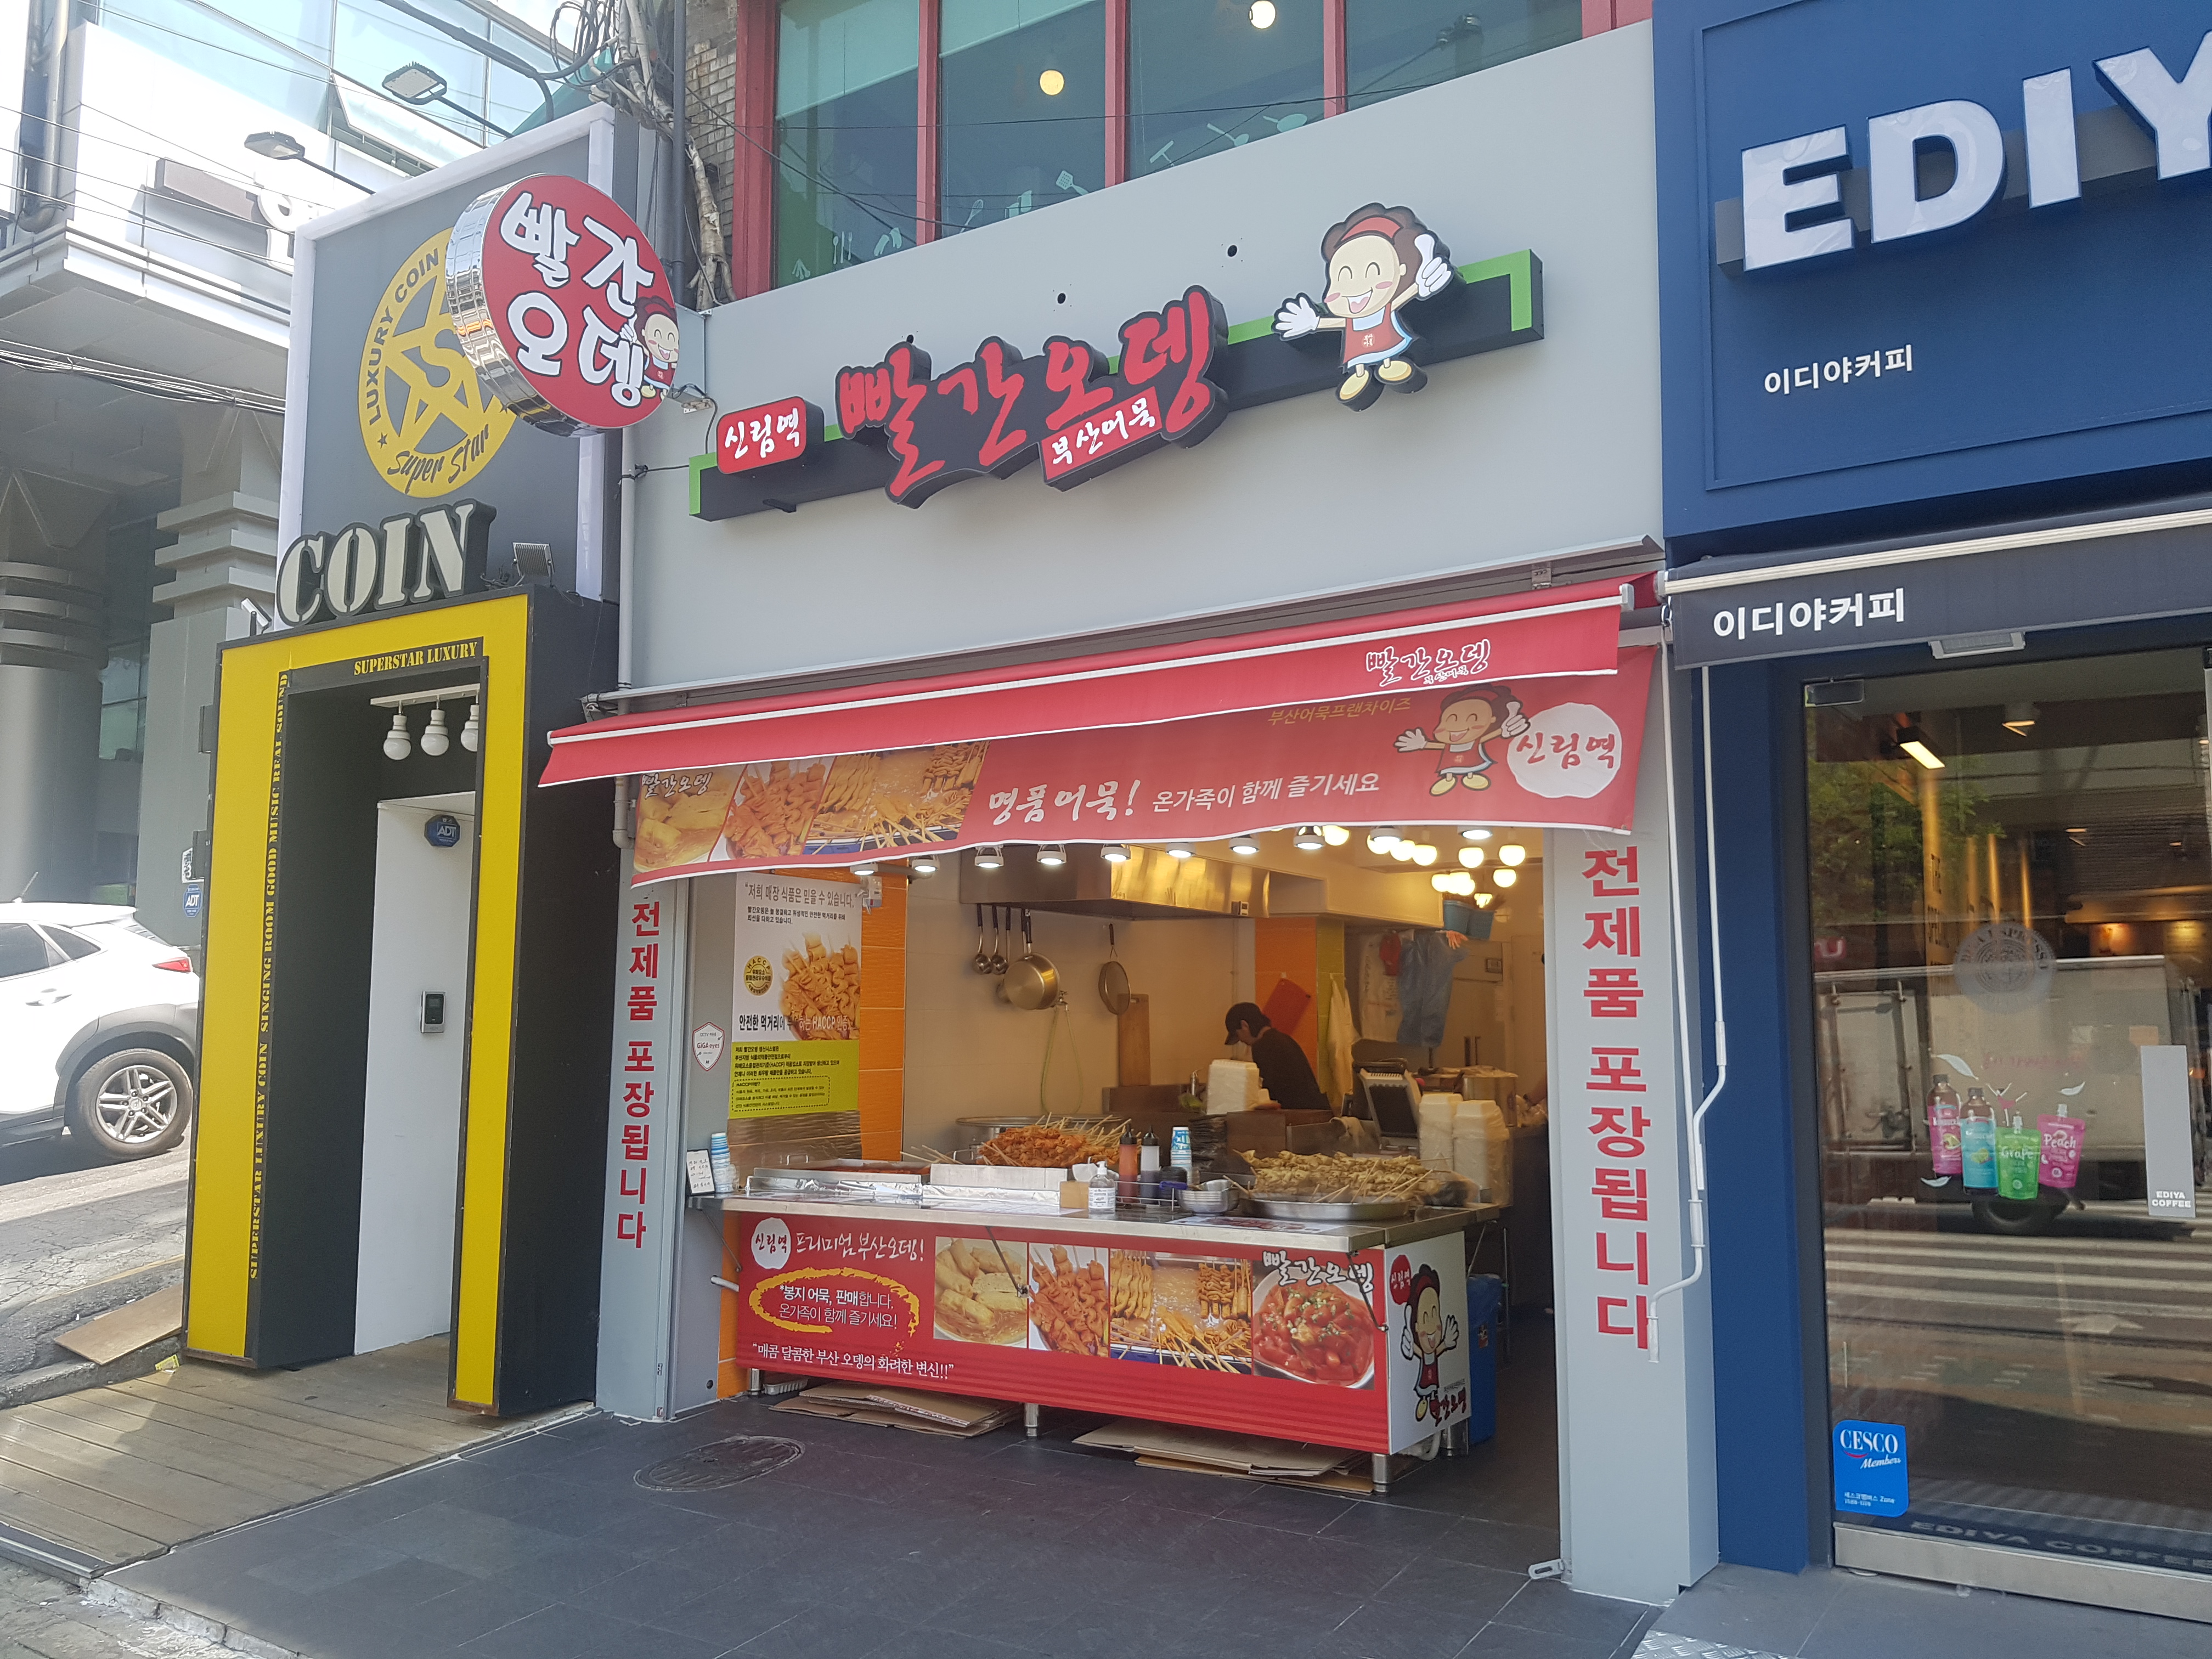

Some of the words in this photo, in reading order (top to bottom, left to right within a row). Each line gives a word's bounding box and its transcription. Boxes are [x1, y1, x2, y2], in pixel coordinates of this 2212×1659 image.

[500, 193, 655, 318] 빨간
[366, 306, 393, 426] LUXURY
[394, 249, 439, 303] COIN
[506, 291, 644, 408] 오뎅
[1764, 345, 1914, 394] 이디야커피
[839, 290, 1212, 498] 빨간오뎅
[723, 409, 802, 460] 신림역
[1049, 397, 1156, 465] 부산어묵
[387, 450, 444, 494] Super
[448, 424, 489, 484] Star
[277, 502, 475, 627] COIN
[1713, 588, 1904, 639] 이디야커피
[353, 651, 424, 676] SUPERSTAR
[427, 642, 477, 663] LUXURY
[1366, 639, 1491, 687] 빨간오뎅
[276, 674, 288, 732] SOUND
[1268, 697, 1410, 725] 부산어묵프랜차이즈
[273, 736, 282, 782] REAL
[1516, 732, 1616, 769] 신림역
[642, 771, 713, 800] 빨간오뎅
[989, 785, 1048, 826] 명품
[1054, 779, 1141, 821] 어묵!
[1153, 788, 1234, 813] 온가족이
[1241, 777, 1283, 805] 함께
[1286, 772, 1380, 798] 즐기세요
[269, 787, 280, 842] MUSIC
[437, 826, 456, 837] ADT
[267, 848, 277, 896] GOOD
[765, 884, 779, 901] 매장
[781, 887, 802, 904] 식품은
[804, 889, 817, 905] 믿을
[819, 890, 825, 906] 수
[185, 895, 200, 907] ADT
[264, 901, 274, 952] ROOM
[1582, 846, 1644, 1018] 전제품
[627, 900, 660, 1022] 전제품
[747, 957, 770, 970] HACCP
[261, 958, 272, 1032] SINGING
[740, 1015, 759, 1031] 안전한
[761, 1014, 785, 1031] 먹거리에
[812, 1016, 836, 1029] HACCP
[258, 1043, 267, 1086] COIN
[255, 1091, 265, 1164] LUXURY
[617, 1041, 655, 1249] 포장됩니다
[2044, 1133, 2076, 1148] Peach
[2002, 1146, 2033, 1159] Grape
[1585, 1047, 1651, 1352] 포장됩니다
[2152, 1199, 2191, 1208] COFFEE
[2156, 1190, 2186, 1199] EDIYA
[250, 1170, 262, 1279] SUPERSTAR
[755, 1232, 788, 1255] 신림역
[795, 1232, 854, 1259] 프리미엄
[1262, 1250, 1374, 1293] 빨간오뎅
[779, 1304, 821, 1323] 온가족이
[824, 1307, 847, 1324] 함께
[848, 1310, 898, 1330] 즐기세요!
[781, 1345, 815, 1363] 달콤한
[816, 1350, 839, 1366] 부산
[841, 1352, 874, 1371] 오뎅의
[877, 1355, 914, 1375] 화려한
[1840, 1429, 1898, 1453] CESCO
[1860, 1454, 1901, 1469] Members
[1910, 1522, 2029, 1544] EDIYA
